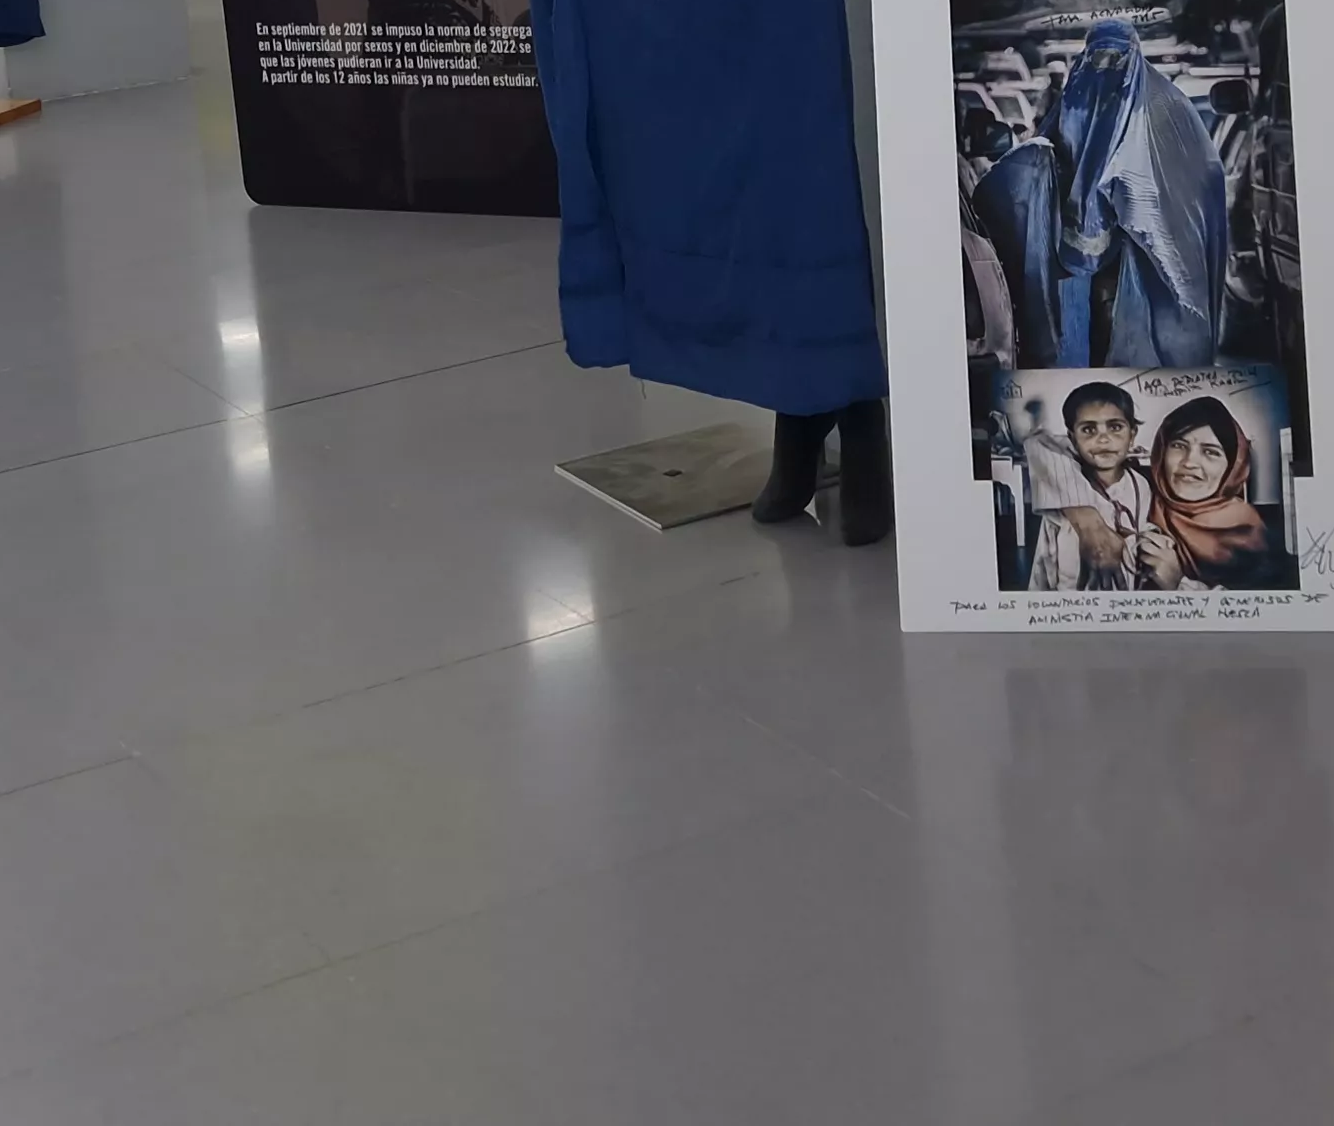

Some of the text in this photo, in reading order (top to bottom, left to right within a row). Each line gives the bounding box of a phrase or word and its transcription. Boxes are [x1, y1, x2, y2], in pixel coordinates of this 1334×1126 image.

[256, 22, 268, 35] En
[271, 22, 326, 38] septiembre
[329, 22, 341, 35] de
[344, 22, 367, 35] 2021
[371, 25, 383, 36] se
[385, 22, 422, 38] impuso
[424, 23, 435, 36] la
[437, 26, 471, 37] norma
[473, 23, 487, 37] de
[258, 38, 532, 55] en la Universidad por sexos y en diciembre de 2022 se
[260, 54, 481, 70] que las jóvenes pudieran ir a la Universidad.
[262, 70, 539, 88] A partir de los 12 años las niñas ya no pueden estudiar.
